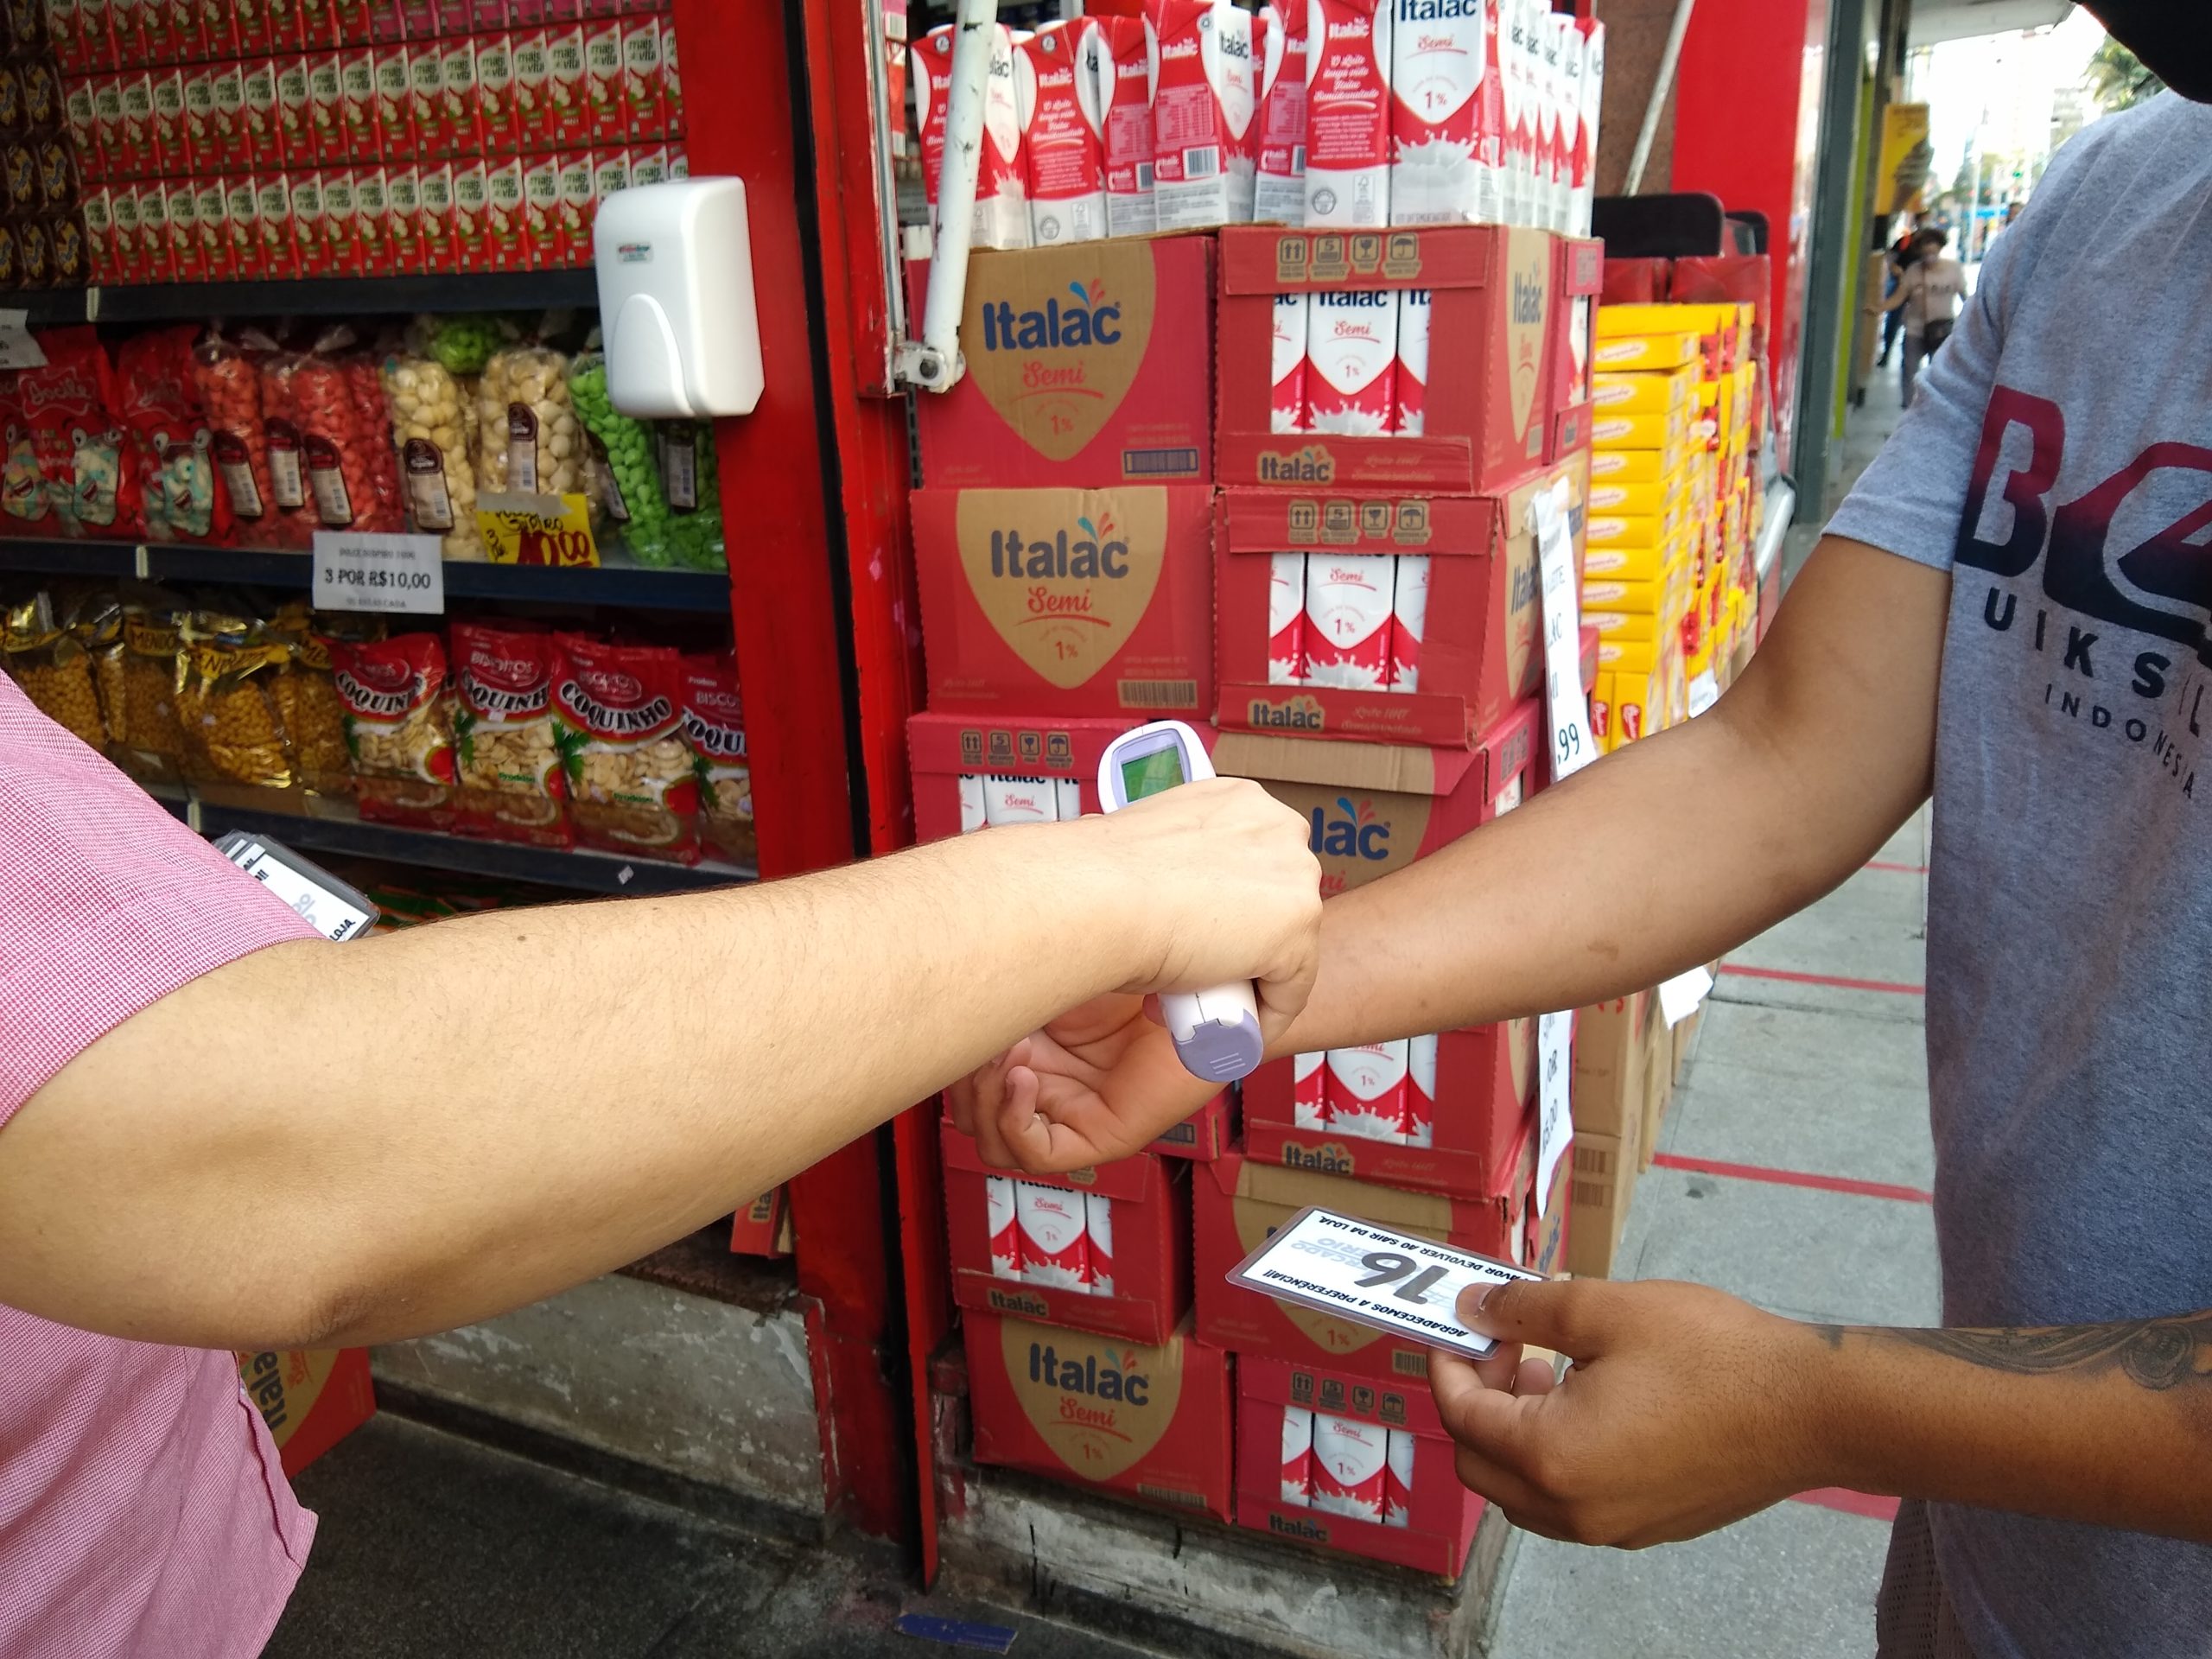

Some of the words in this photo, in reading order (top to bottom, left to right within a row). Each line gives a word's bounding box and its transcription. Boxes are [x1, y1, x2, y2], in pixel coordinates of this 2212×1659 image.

[1219, 29, 1249, 60] Italac
[1425, 91, 1447, 109] 1%
[983, 298, 1122, 352] Italac
[1334, 320, 1372, 336] Semi
[1023, 359, 1086, 388] Semi
[1261, 456, 1331, 482] Italac
[991, 530, 1128, 579] Italac
[324, 568, 334, 584] 3
[338, 569, 365, 587] POR
[369, 570, 431, 591] R$10,00
[1330, 568, 1363, 582] Semi
[1027, 586, 1093, 614] Semi
[1334, 618, 1356, 635] 1%
[1054, 639, 1079, 661] 1%
[560, 679, 672, 733] COQUINHO
[1253, 702, 1321, 729] Italac
[2045, 683, 2196, 799] INDONESIA
[1286, 1146, 1351, 1174] Italac
[1319, 1215, 1351, 1230] LOJA.
[1350, 1226, 1369, 1236] DA
[1370, 1231, 1400, 1246] SAIR
[1401, 1242, 1420, 1251] AO
[1420, 1248, 1484, 1271] DEVOLVER
[1262, 1269, 1358, 1304] PREFERÊNCIA!!
[1354, 1252, 1450, 1306] 16
[1484, 1267, 1529, 1281] AVOR
[990, 1291, 1047, 1317] Italac
[1358, 1299, 1371, 1307] A
[1371, 1304, 1470, 1338] AGRADECEMOS
[1327, 1327, 1351, 1347] 1%
[1029, 1342, 1150, 1407] Italac
[1059, 1397, 1116, 1427] Semi
[1083, 1442, 1103, 1461] 1%
[1269, 1513, 1328, 1543] Italac
